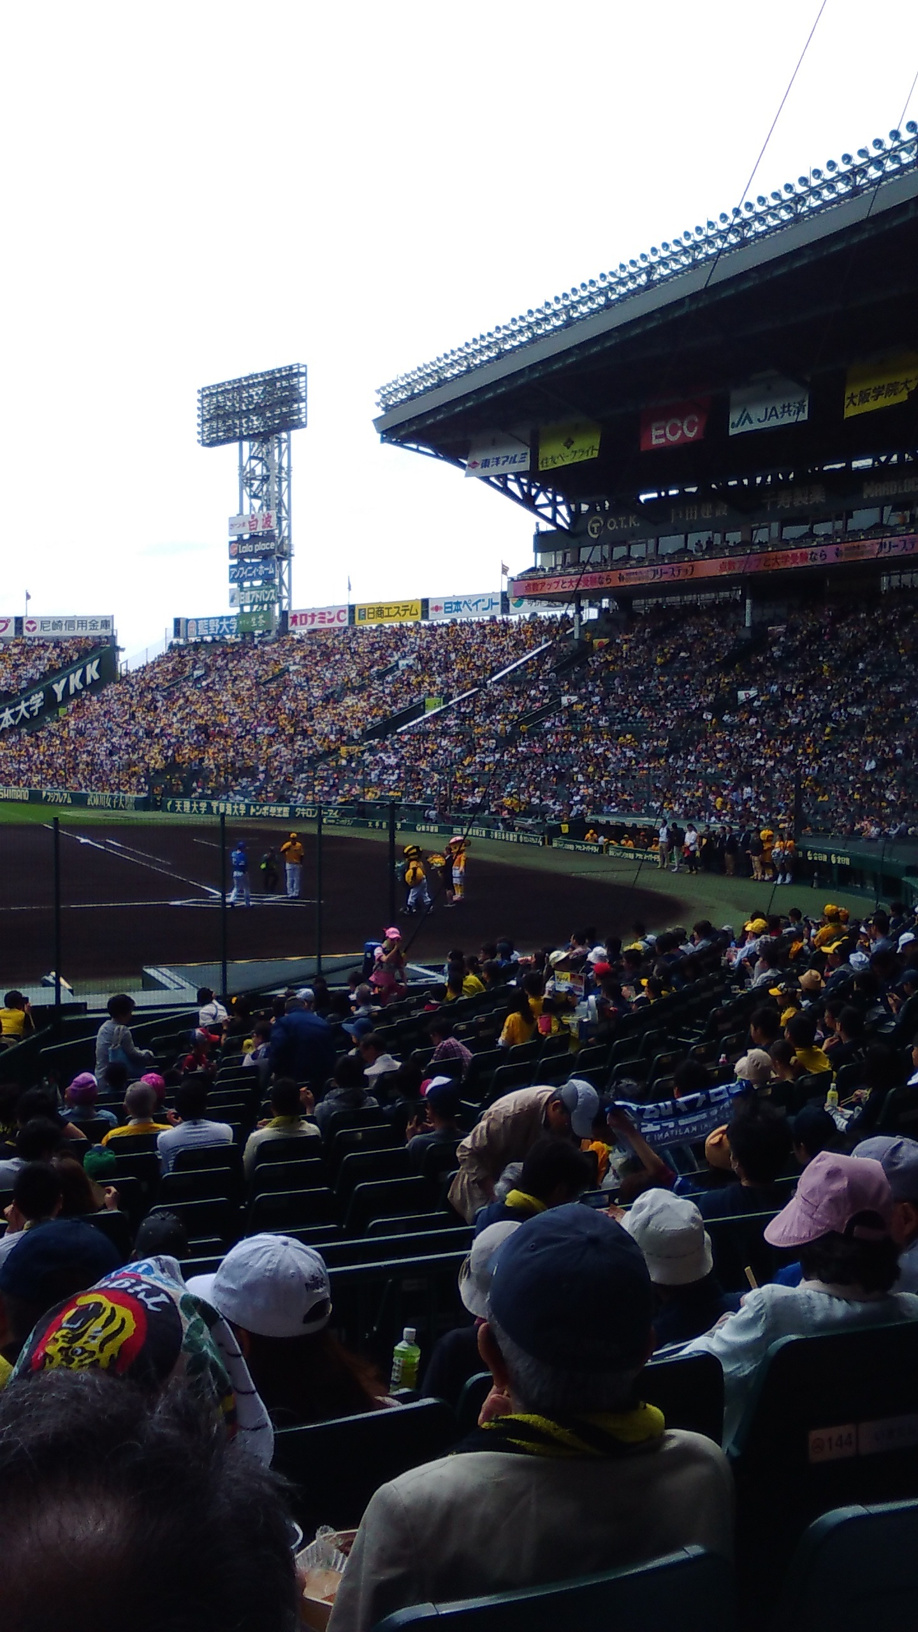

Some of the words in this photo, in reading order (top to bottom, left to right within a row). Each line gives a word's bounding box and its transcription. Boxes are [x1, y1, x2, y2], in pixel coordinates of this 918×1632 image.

[846, 378, 918, 409] 大阪学院大
[757, 400, 807, 424] JA共済
[652, 415, 699, 445] ECC
[480, 452, 528, 469] 東洋アルミ
[541, 445, 599, 469] 住友ベークライト
[248, 513, 274, 532] 白波
[367, 604, 419, 621] 日商エステム
[443, 598, 499, 615] 日本ペイント
[40, 619, 111, 632] 尼崎信用金庫
[290, 609, 347, 628] オロナミンC
[52, 658, 101, 703] YKK
[175, 801, 207, 815] 天理大学
